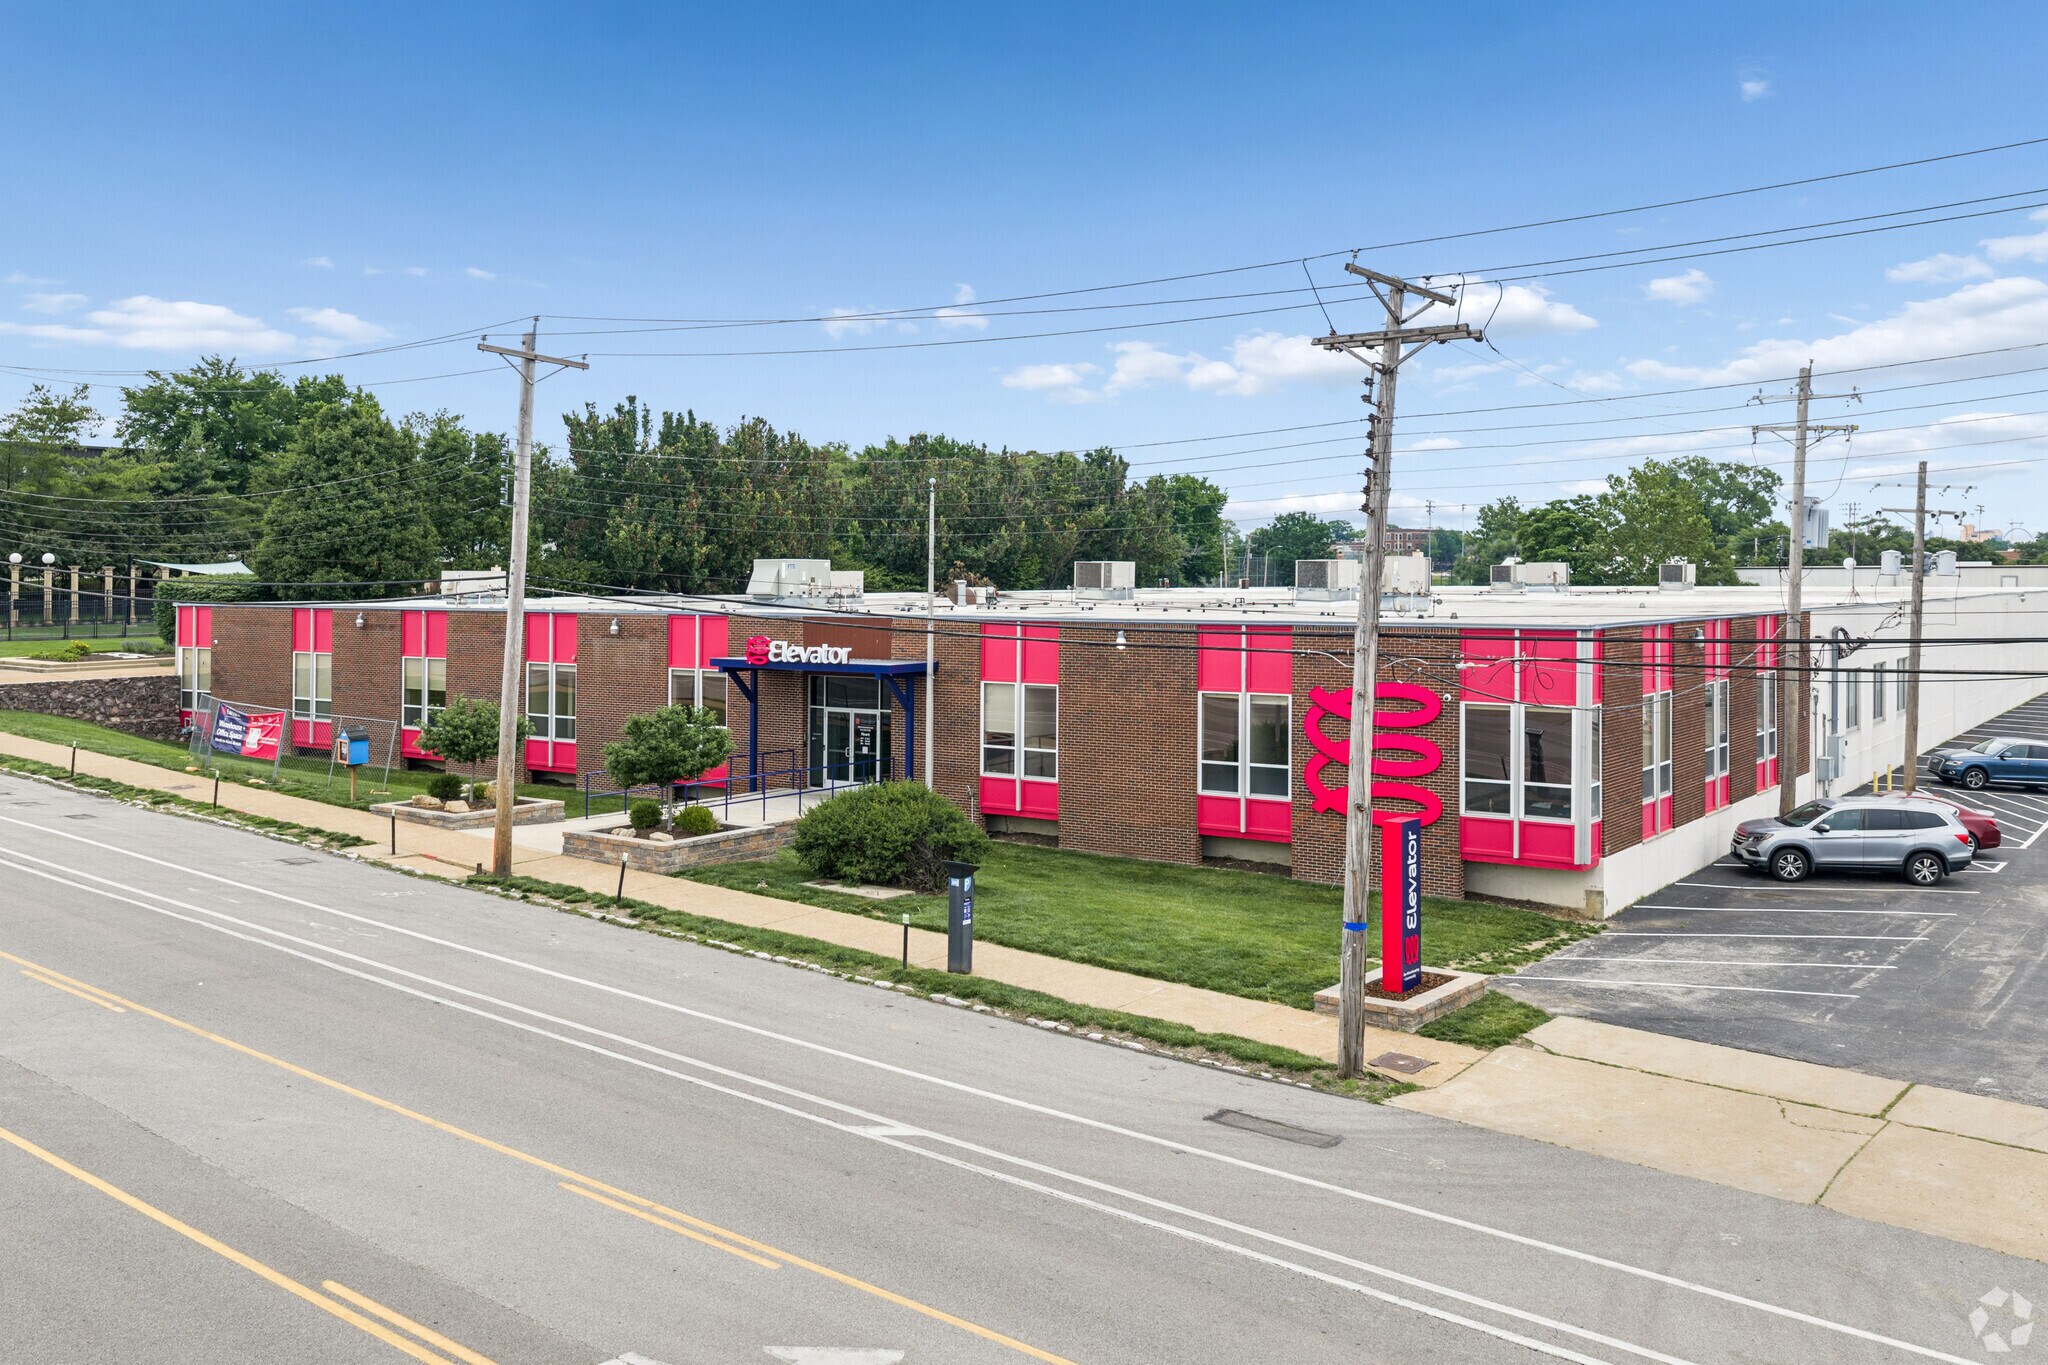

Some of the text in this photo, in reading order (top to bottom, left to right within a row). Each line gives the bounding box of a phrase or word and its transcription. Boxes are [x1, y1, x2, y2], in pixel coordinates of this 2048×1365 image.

[768, 640, 852, 664] Elevator
[219, 720, 242, 731] Warehouse
[216, 729, 243, 740] Office Space
[1406, 831, 1417, 930] Elevator
